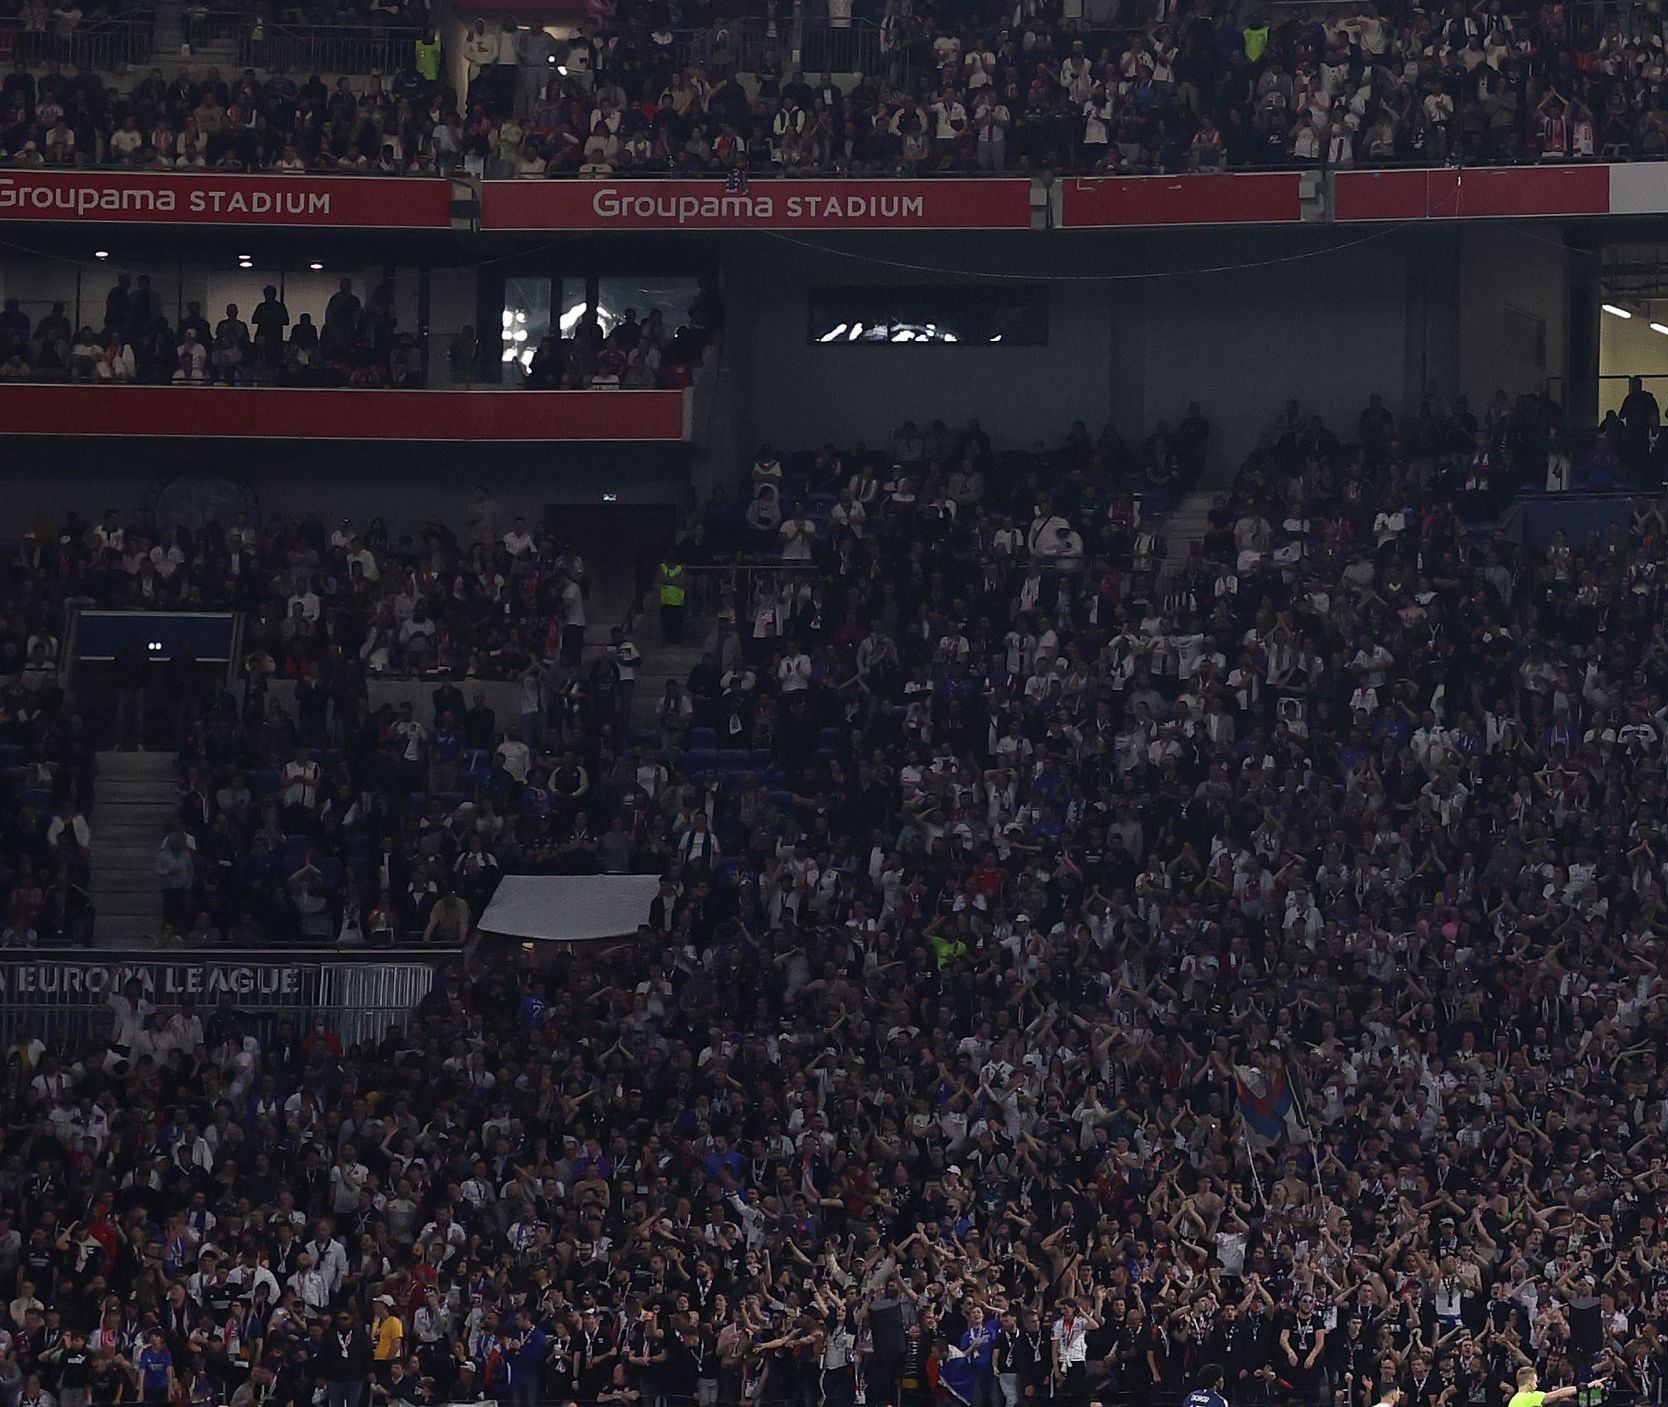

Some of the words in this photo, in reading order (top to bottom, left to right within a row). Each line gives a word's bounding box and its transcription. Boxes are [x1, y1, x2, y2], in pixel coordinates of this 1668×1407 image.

[0, 179, 176, 216] Groupama
[190, 191, 330, 214] STADIUM
[592, 189, 773, 223] Groupama
[786, 196, 923, 217] STADIUM
[166, 966, 300, 993] LEAGUE
